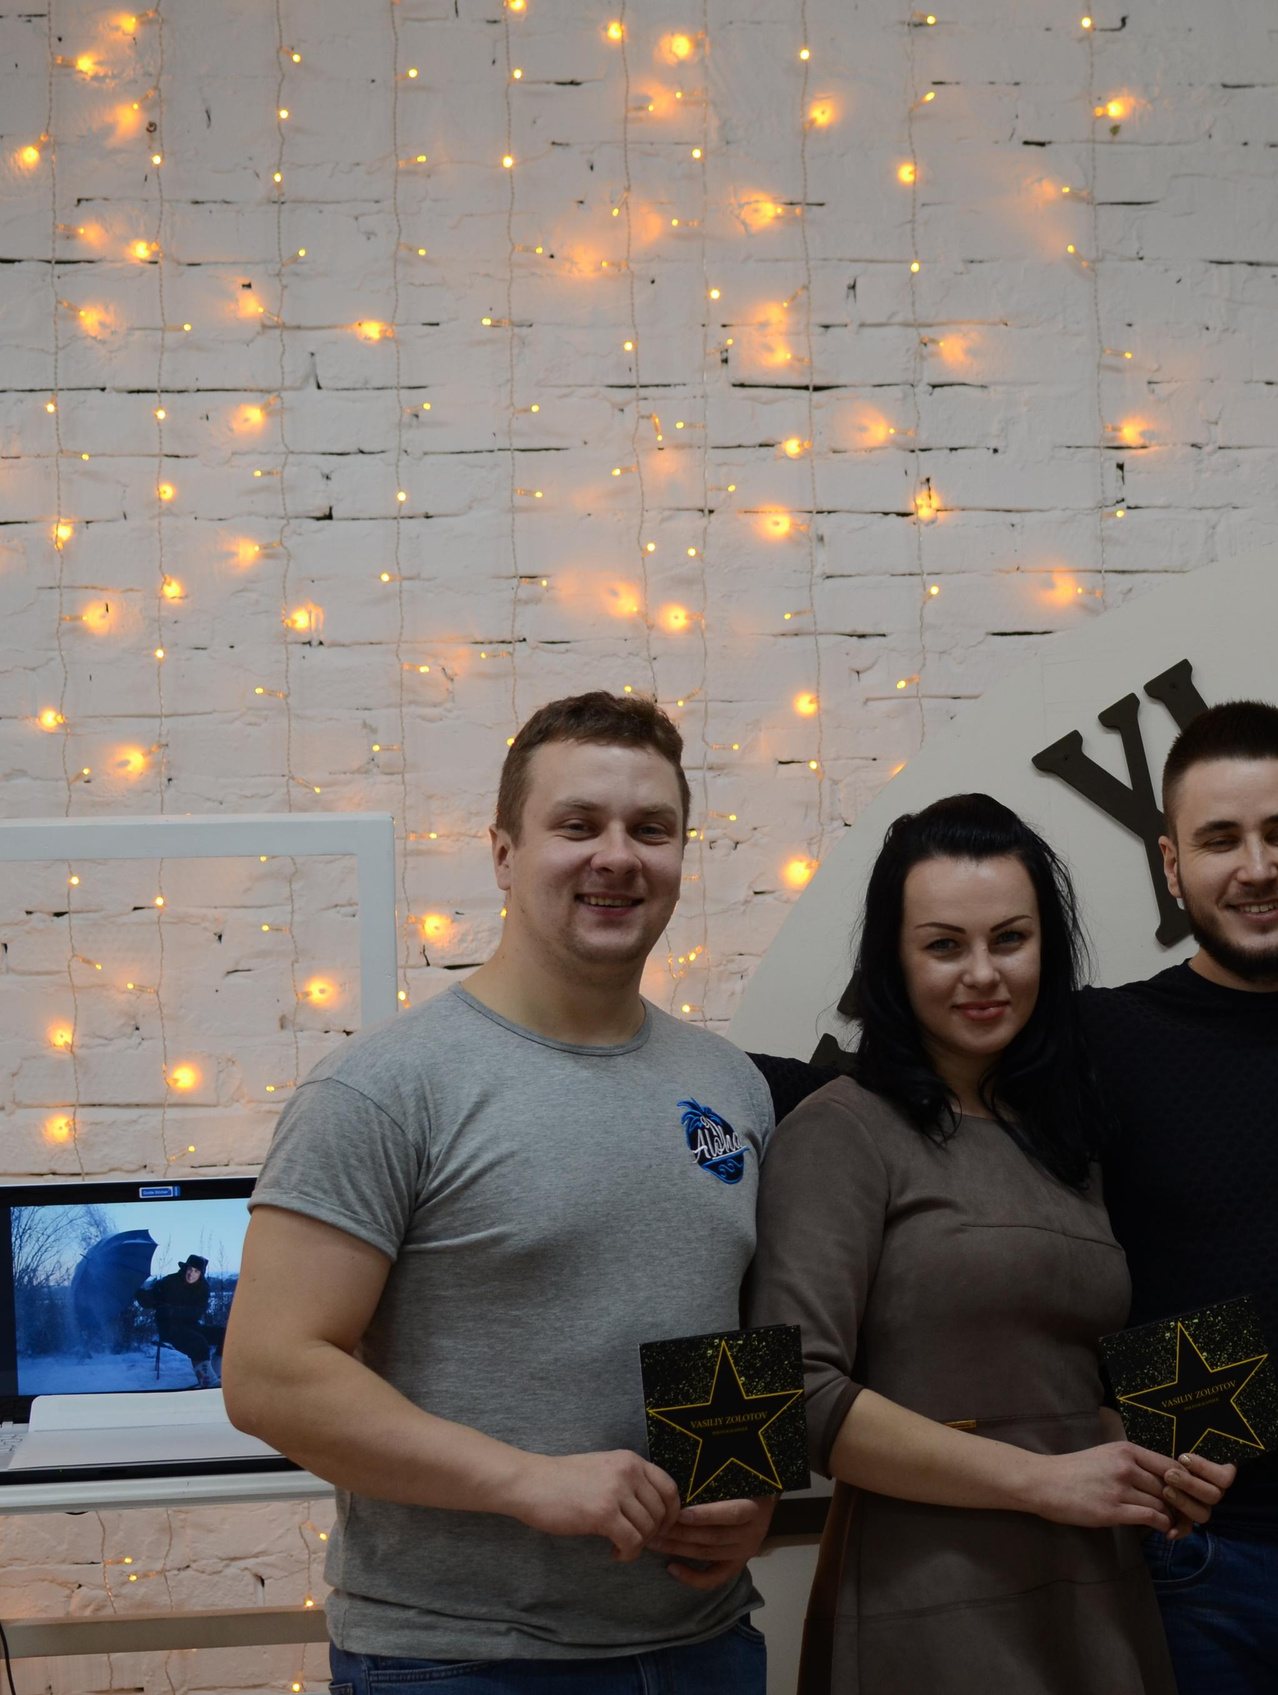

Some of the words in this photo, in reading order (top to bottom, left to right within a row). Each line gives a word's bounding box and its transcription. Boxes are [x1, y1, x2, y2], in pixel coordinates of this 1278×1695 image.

[692, 1122, 744, 1163] Aloha
[1161, 1392, 1194, 1408] VASILIY
[1195, 1380, 1236, 1399] ZOLOTOV
[690, 1417, 724, 1429] VASILIY
[725, 1411, 768, 1425] ZOLOTOV
